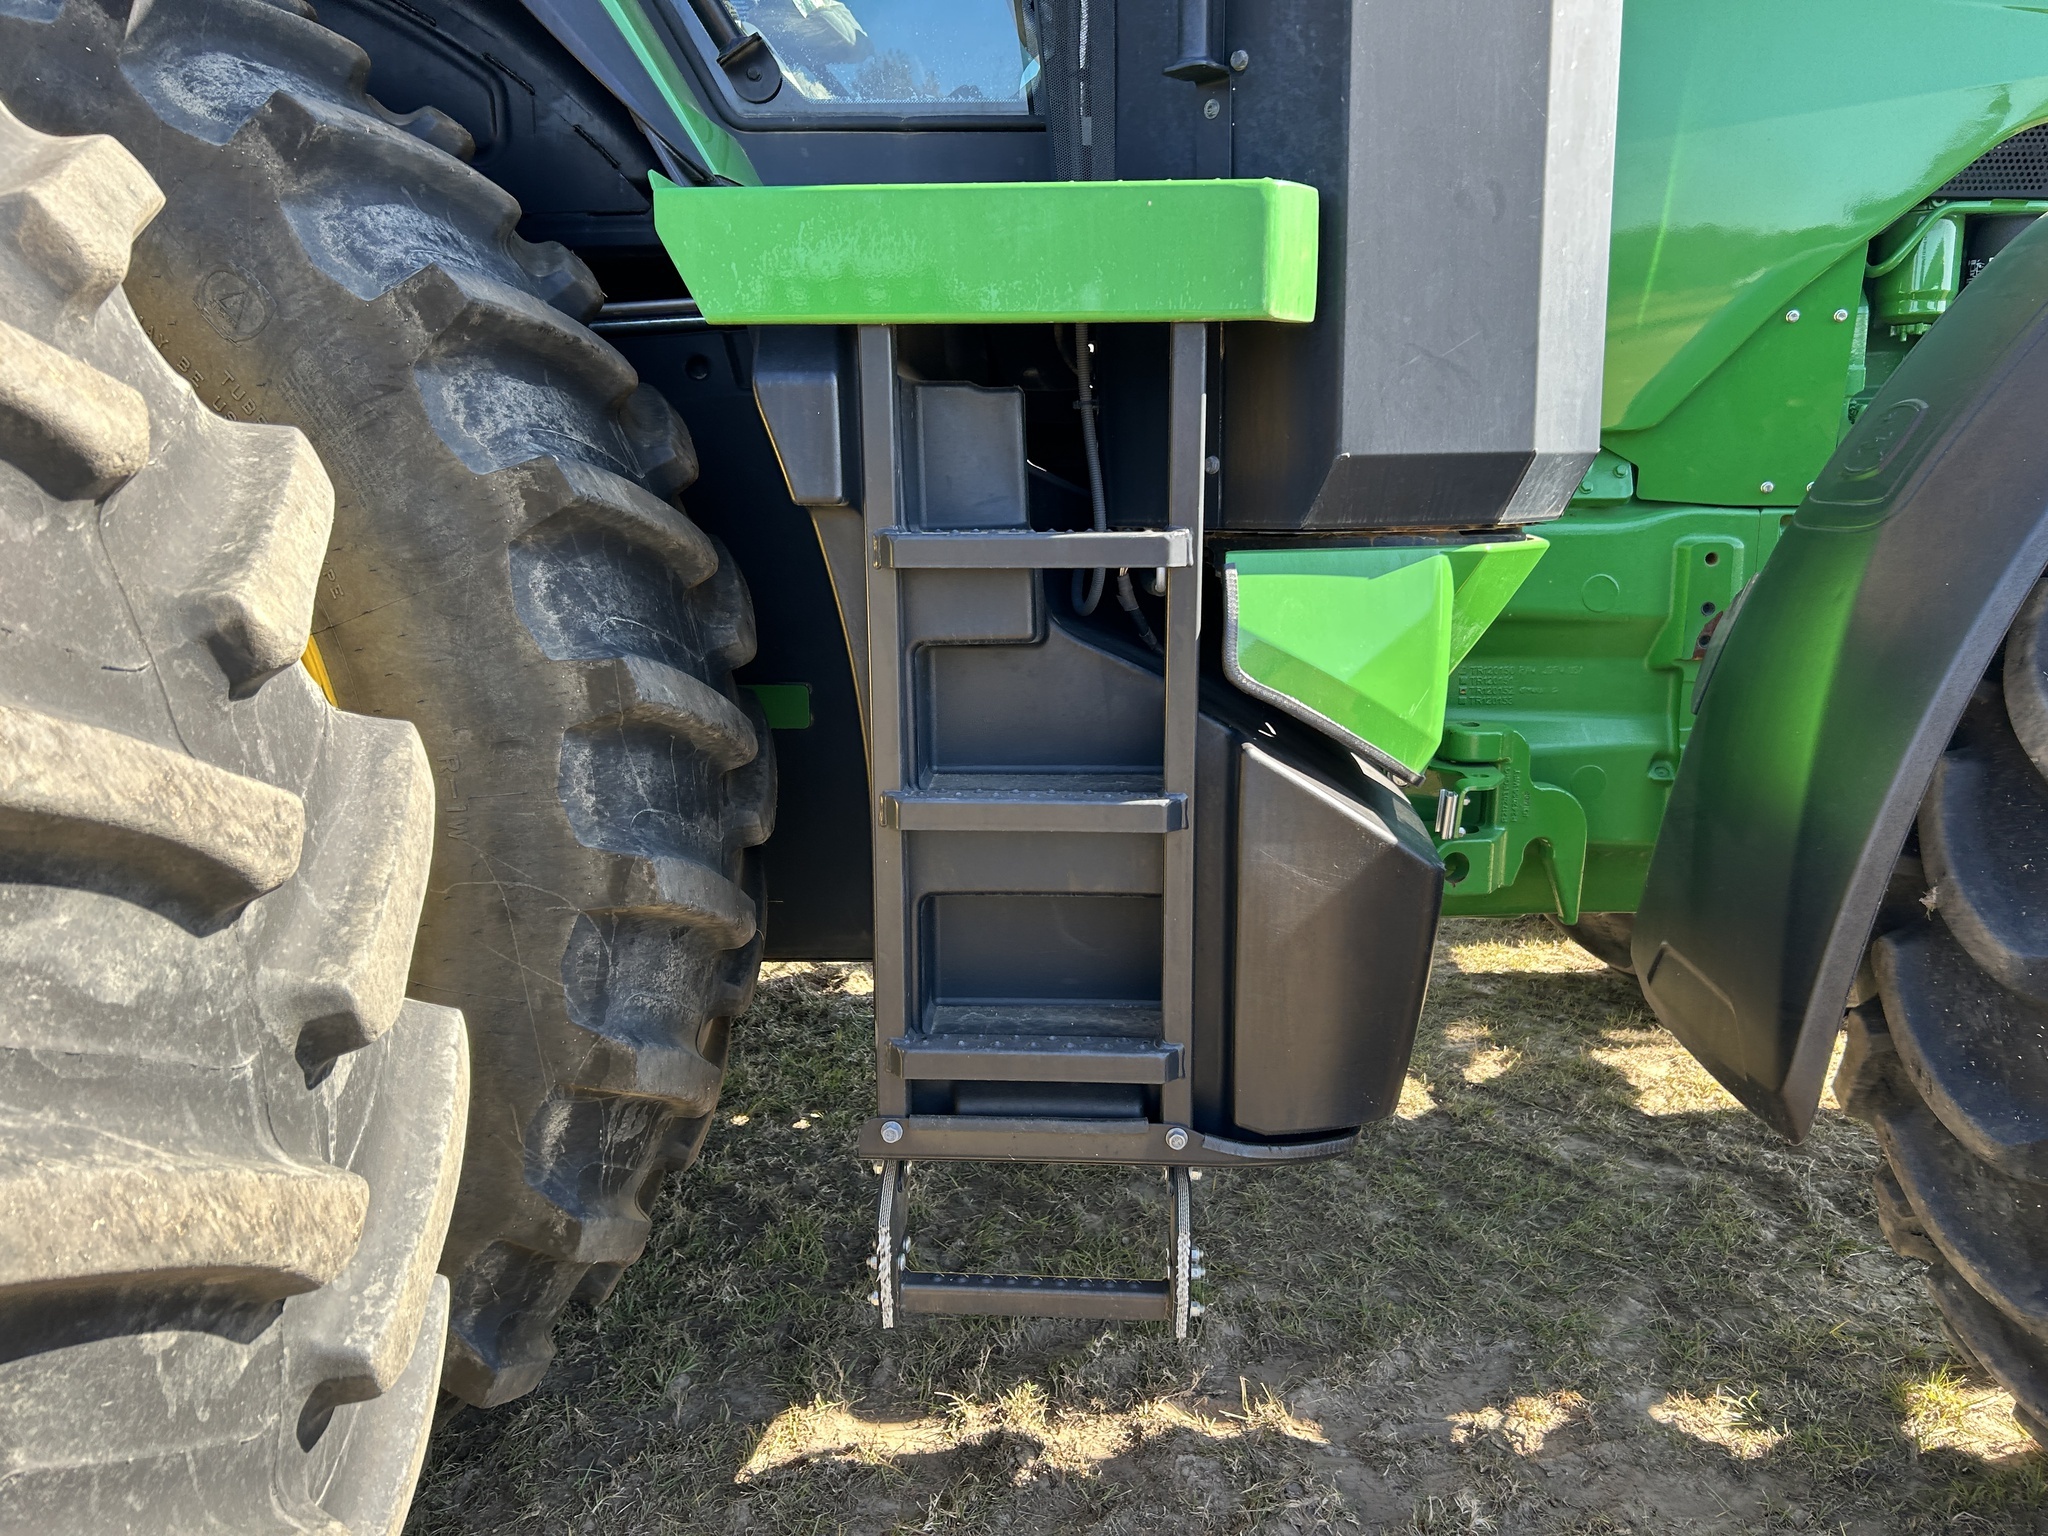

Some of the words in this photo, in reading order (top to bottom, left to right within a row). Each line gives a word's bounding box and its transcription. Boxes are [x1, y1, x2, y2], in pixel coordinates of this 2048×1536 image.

[176, 355, 205, 388] BE
[322, 560, 344, 599] PE
[436, 754, 470, 840] R-1W
